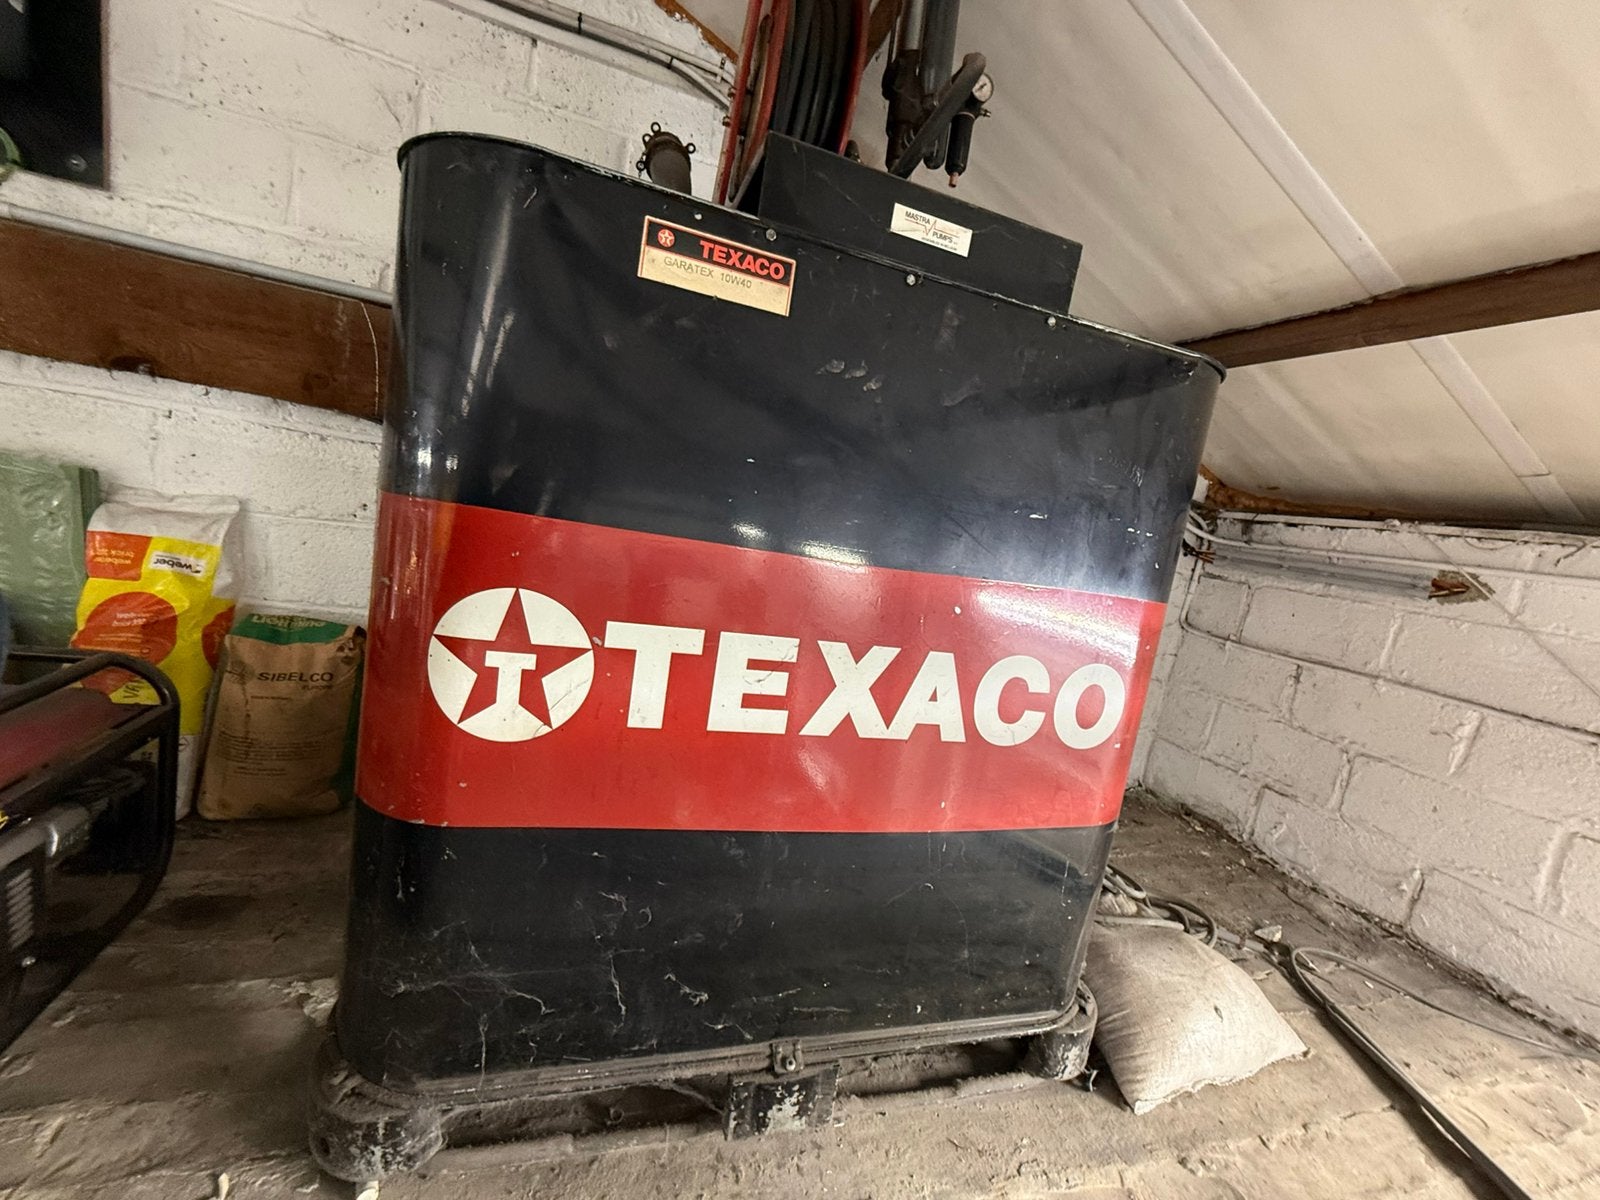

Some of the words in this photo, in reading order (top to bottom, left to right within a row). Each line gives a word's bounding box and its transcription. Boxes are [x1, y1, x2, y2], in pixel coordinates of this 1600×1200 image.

[905, 210, 931, 225] MASTRA
[932, 230, 954, 244] PUMPS
[700, 240, 785, 280] TEXACO
[664, 255, 714, 279] GARATEX
[720, 272, 753, 289] 10W40
[153, 557, 193, 572] weber
[257, 671, 334, 683] SIBELCO
[604, 620, 1126, 750] TEXACO
